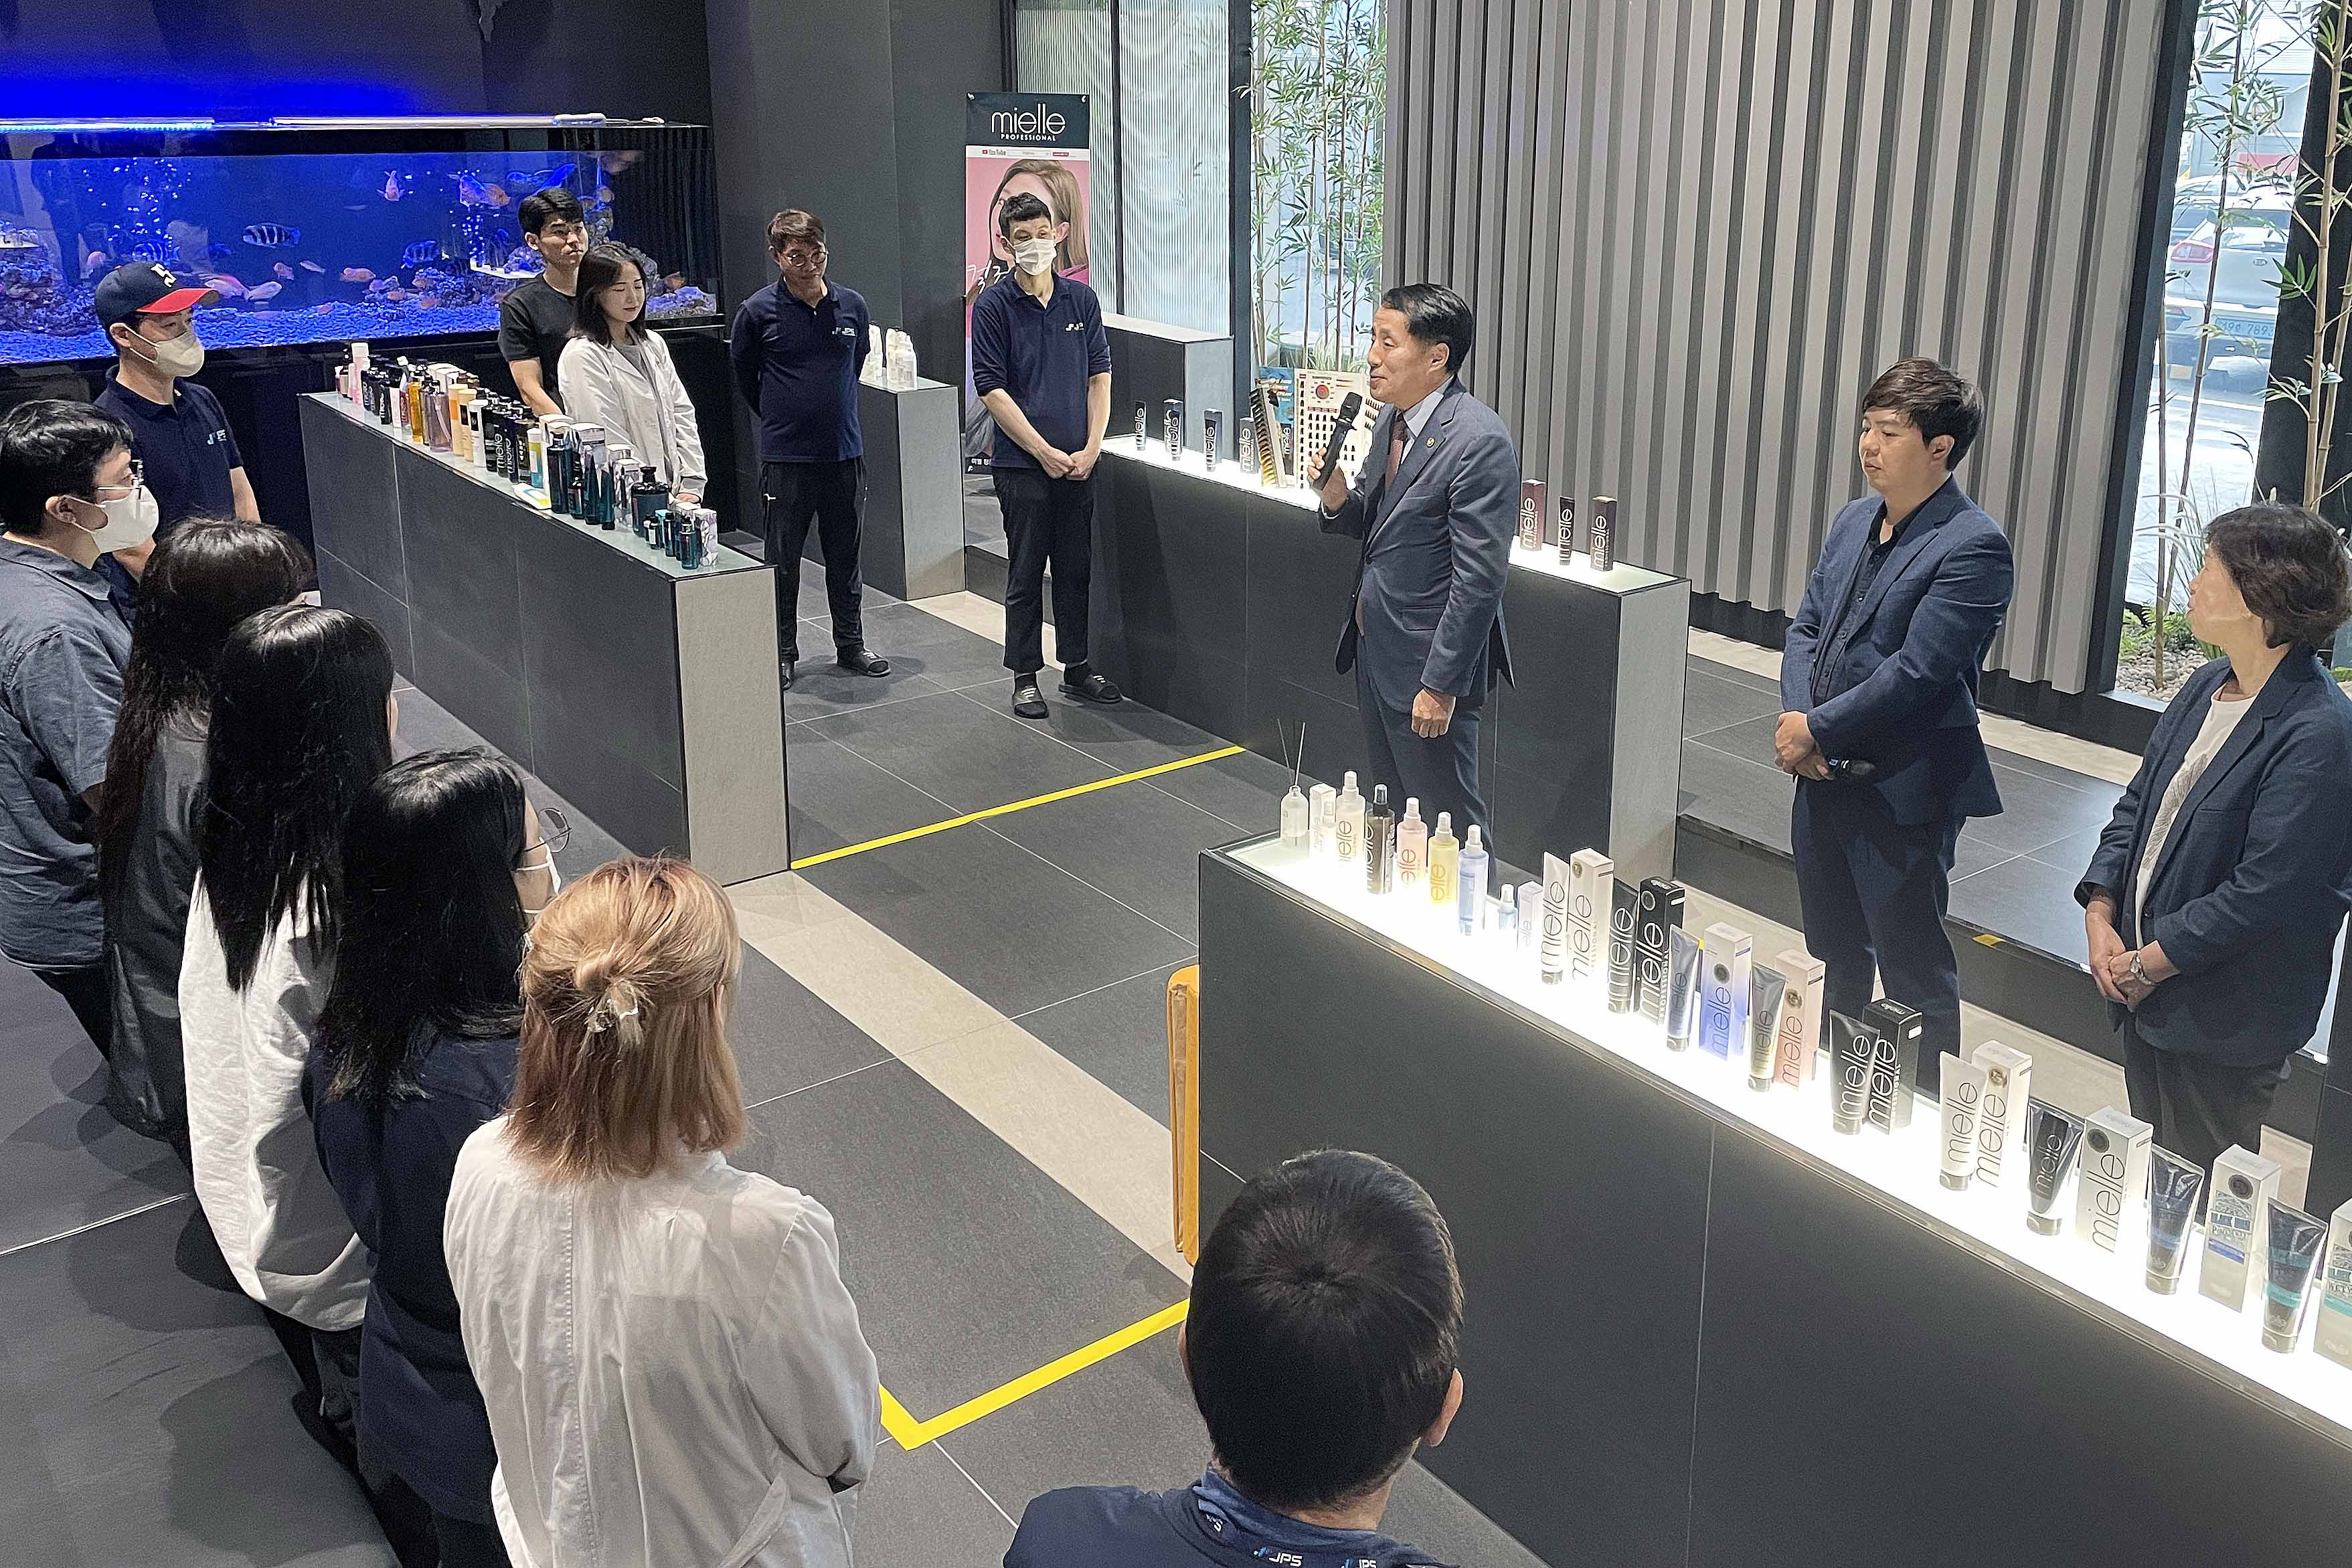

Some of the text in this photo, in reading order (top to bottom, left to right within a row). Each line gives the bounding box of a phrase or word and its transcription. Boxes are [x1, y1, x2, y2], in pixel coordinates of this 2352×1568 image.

[990, 103, 1066, 135] mielle
[494, 433, 504, 468] mielle
[1239, 428, 1251, 471] mielle
[1520, 497, 1535, 549] mielle
[1590, 515, 1607, 568] mielle
[1336, 820, 1351, 862] ielle
[1541, 881, 1565, 966] mielle
[1568, 895, 1592, 980] mielle
[1608, 907, 1634, 998] mielle
[1636, 922, 1664, 1019] mielle
[1707, 986, 1731, 1056] mielle
[1751, 1010, 1774, 1071] mielle
[1778, 1015, 1802, 1087] mielle
[1839, 1034, 1871, 1116] mielle
[1868, 1038, 1896, 1130] mielle
[1946, 1082, 1978, 1163] mielle
[1976, 1094, 2007, 1187] mielle
[2035, 1134, 2062, 1198] mielle
[2086, 1154, 2125, 1253] mielle
[1269, 1552, 1303, 1567] JPS
[1358, 1559, 1377, 1568] JPS
